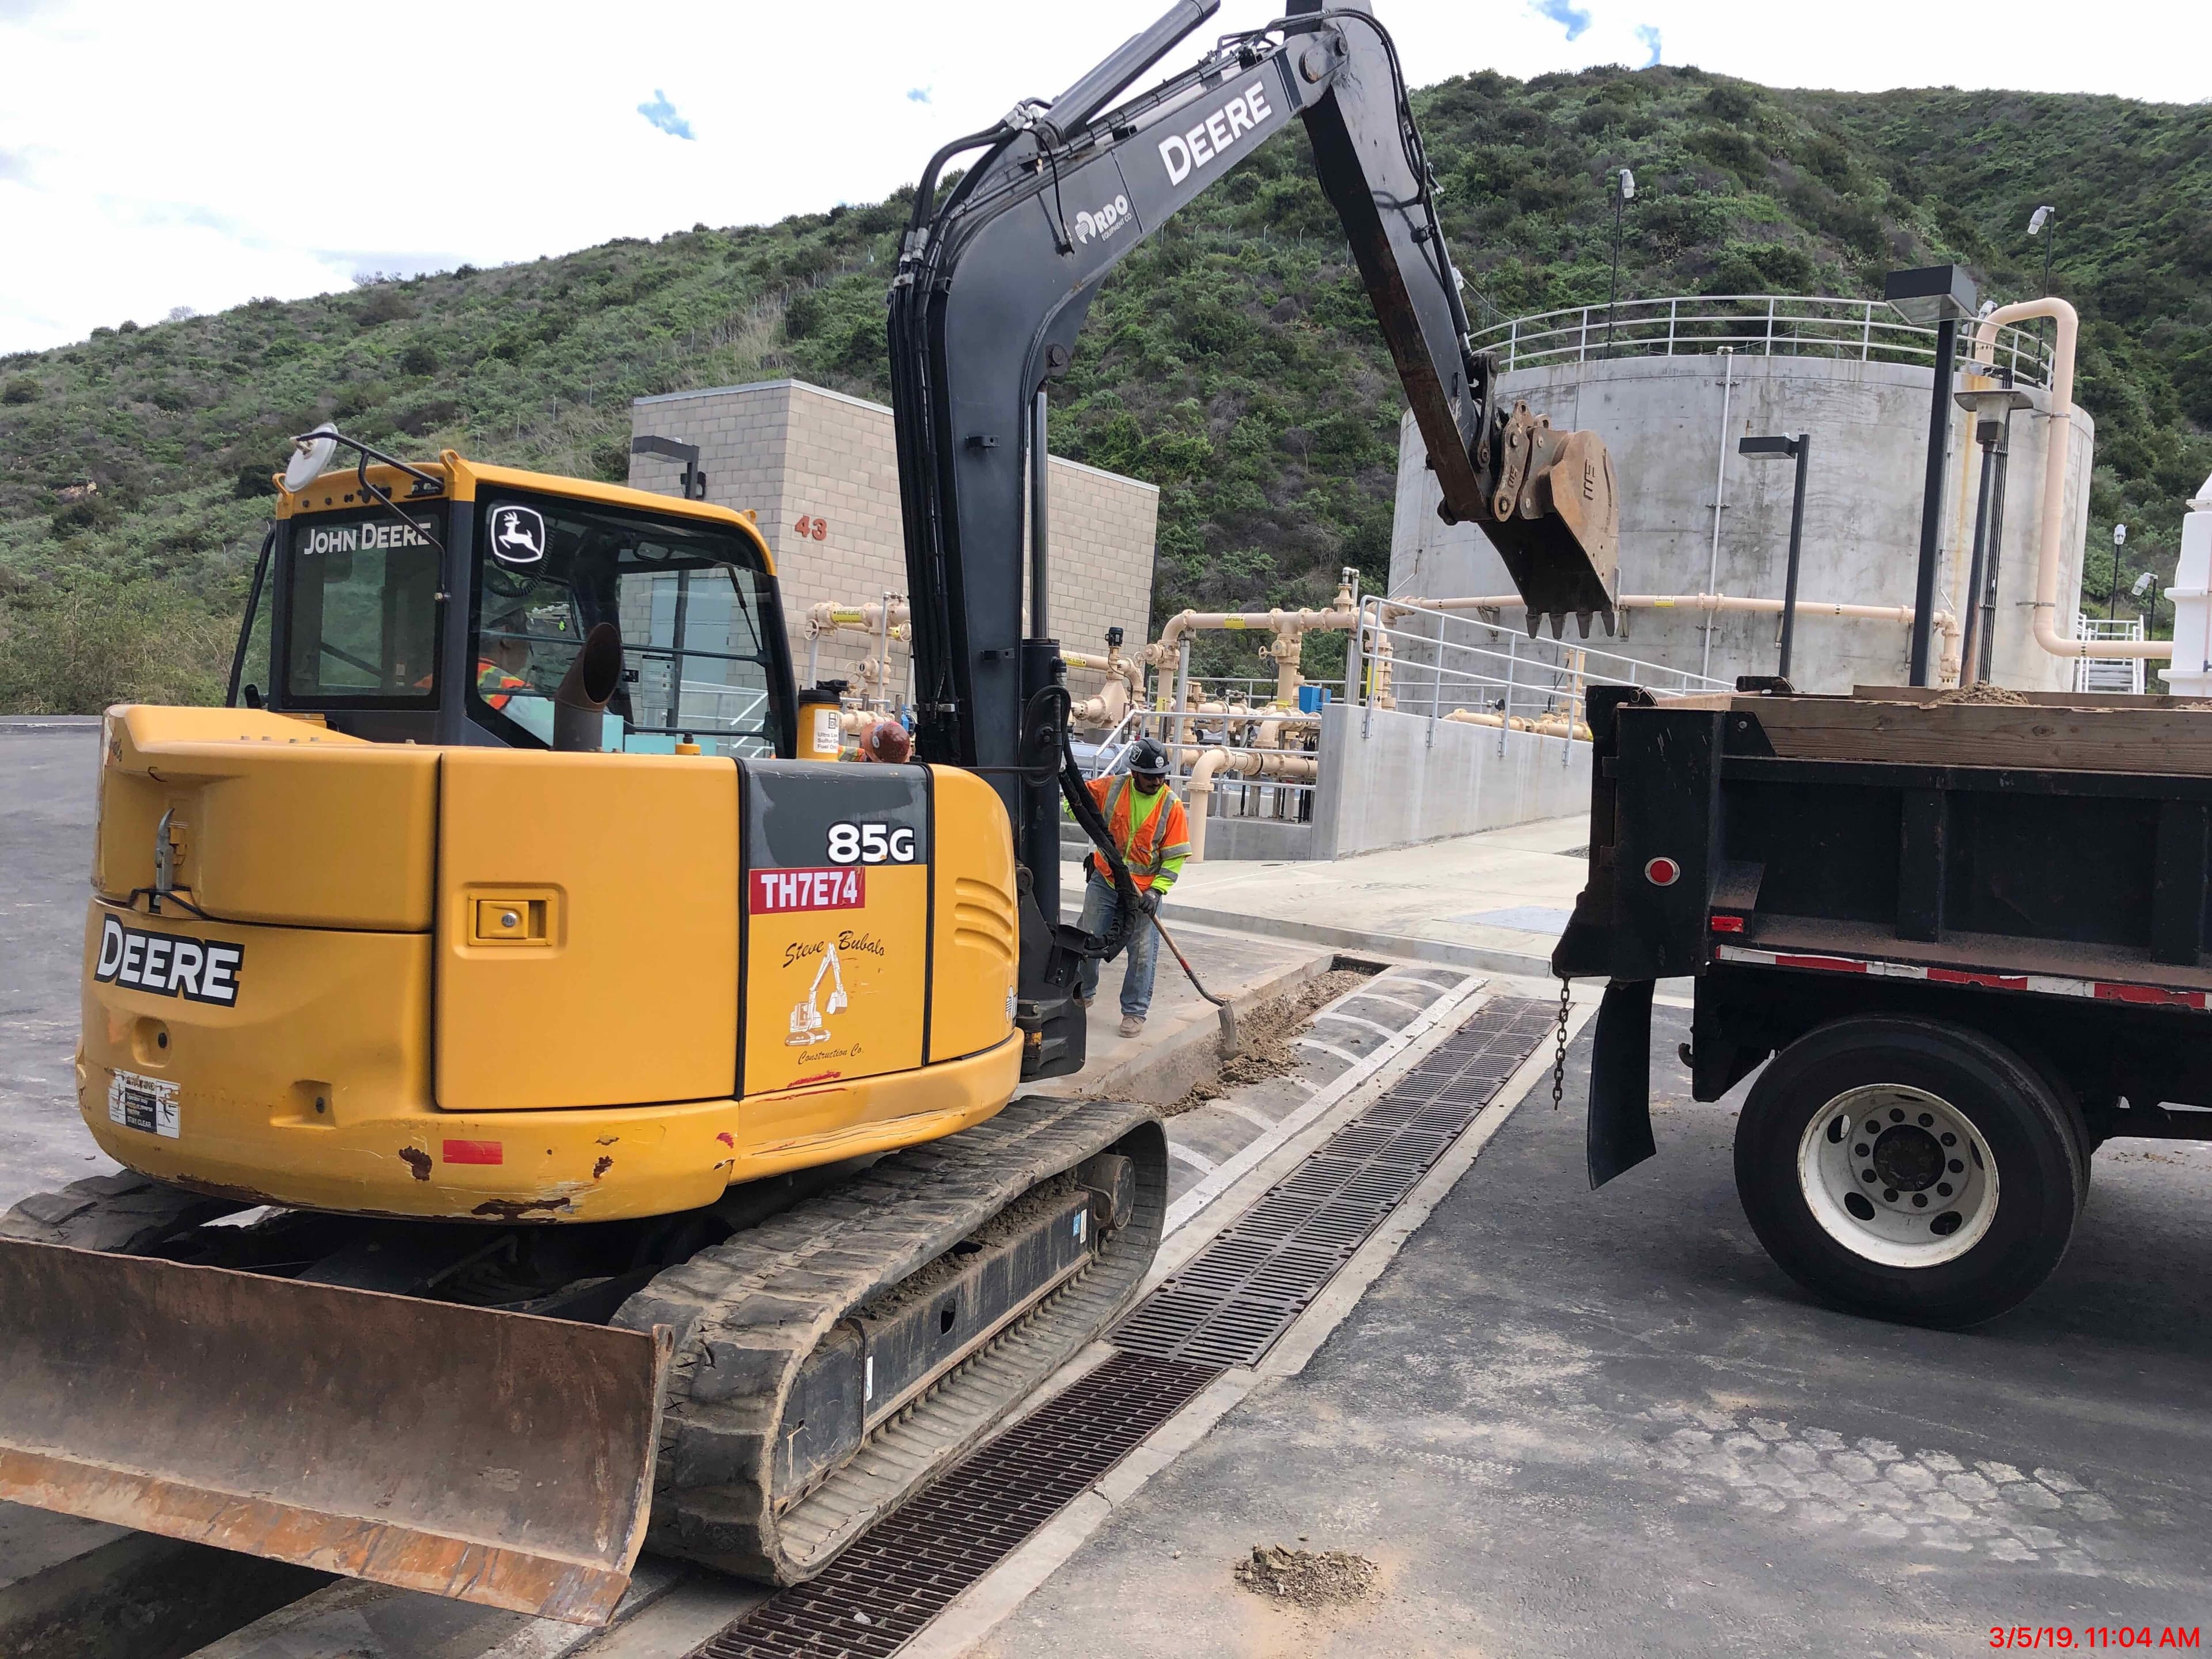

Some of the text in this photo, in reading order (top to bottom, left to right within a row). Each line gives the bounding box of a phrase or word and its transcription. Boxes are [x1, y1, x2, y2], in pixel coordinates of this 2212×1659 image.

[1158, 81, 1272, 186] DEERE
[1093, 195, 1128, 234] RDO
[304, 522, 431, 555] JOHN DEERE
[794, 515, 827, 541] 43
[828, 823, 915, 864] 85G
[760, 870, 858, 909] TH7E74
[96, 918, 240, 1001] DEERE
[782, 930, 885, 968] Steve Bubalo
[798, 1048, 848, 1065] Construction
[137, 1119, 152, 1129] CLEAR
